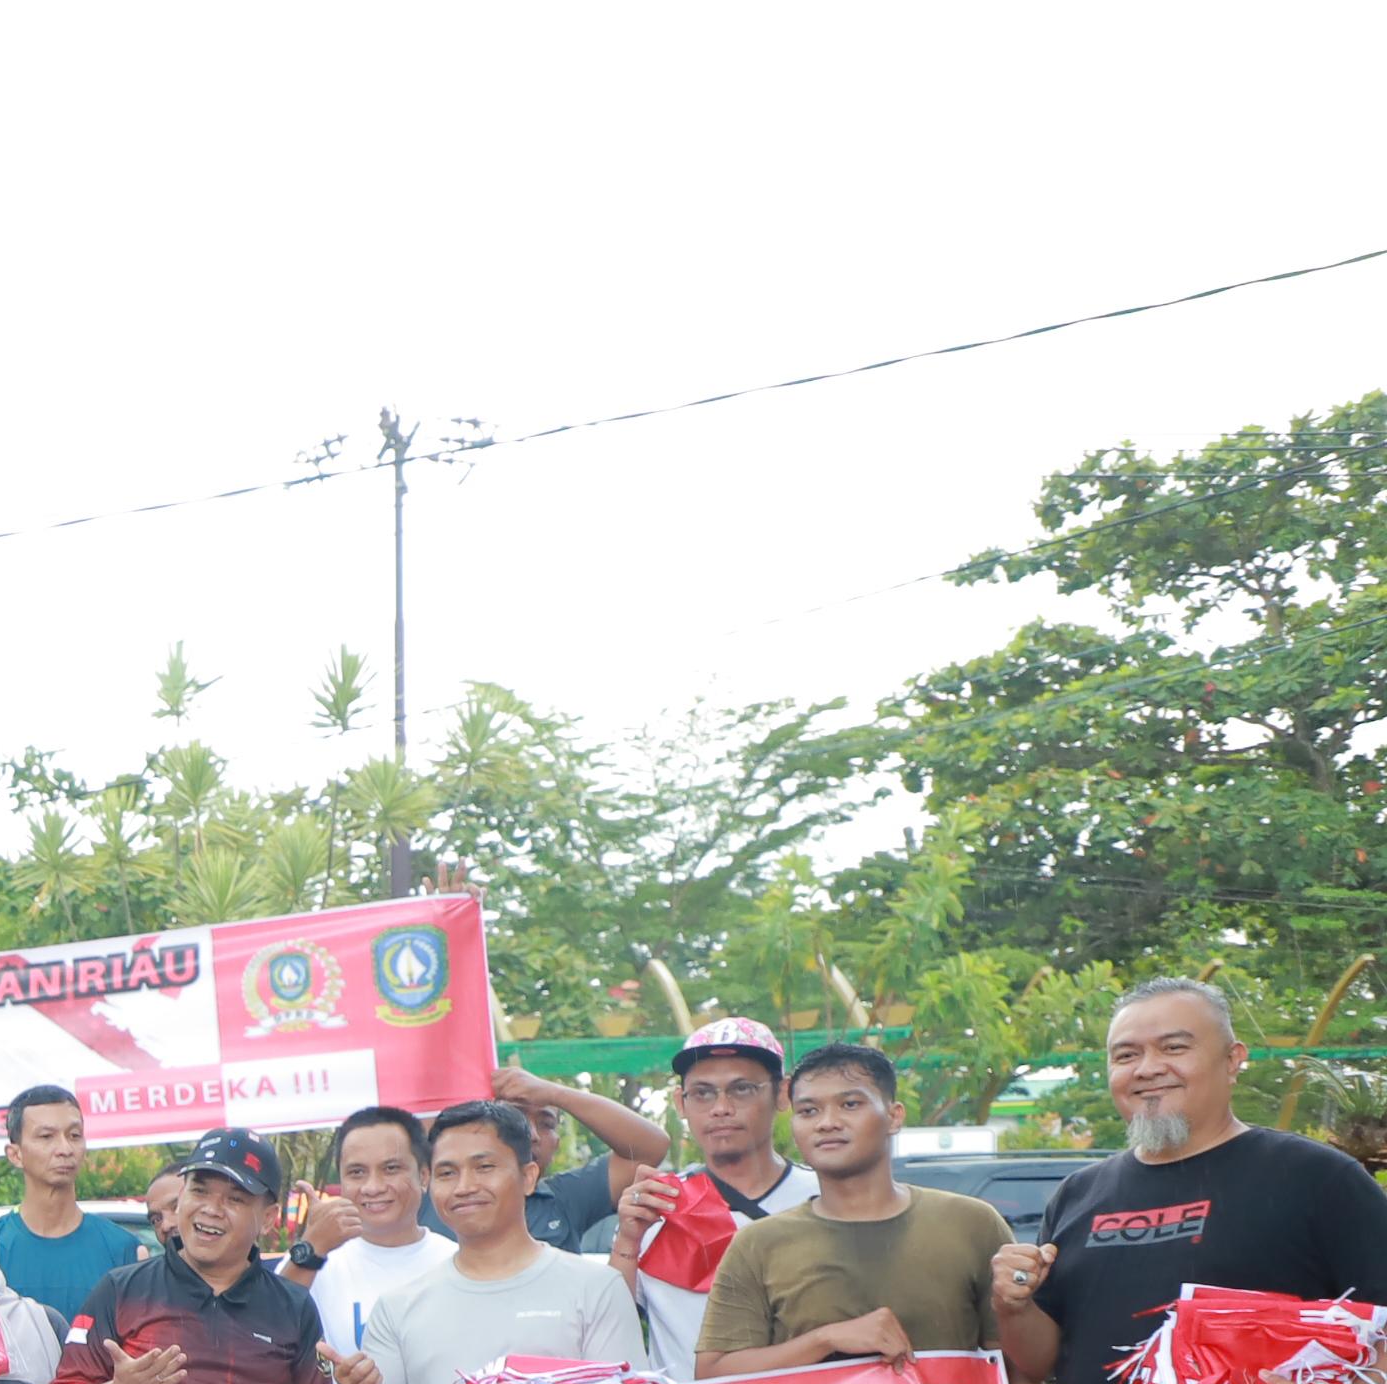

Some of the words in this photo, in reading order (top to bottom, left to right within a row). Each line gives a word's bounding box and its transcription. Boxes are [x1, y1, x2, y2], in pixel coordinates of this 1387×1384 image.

[75, 946, 201, 998] RIAU
[90, 1077, 279, 1113] MERDEKA
[294, 1069, 332, 1095] !!!
[1093, 1206, 1204, 1243] COLE
